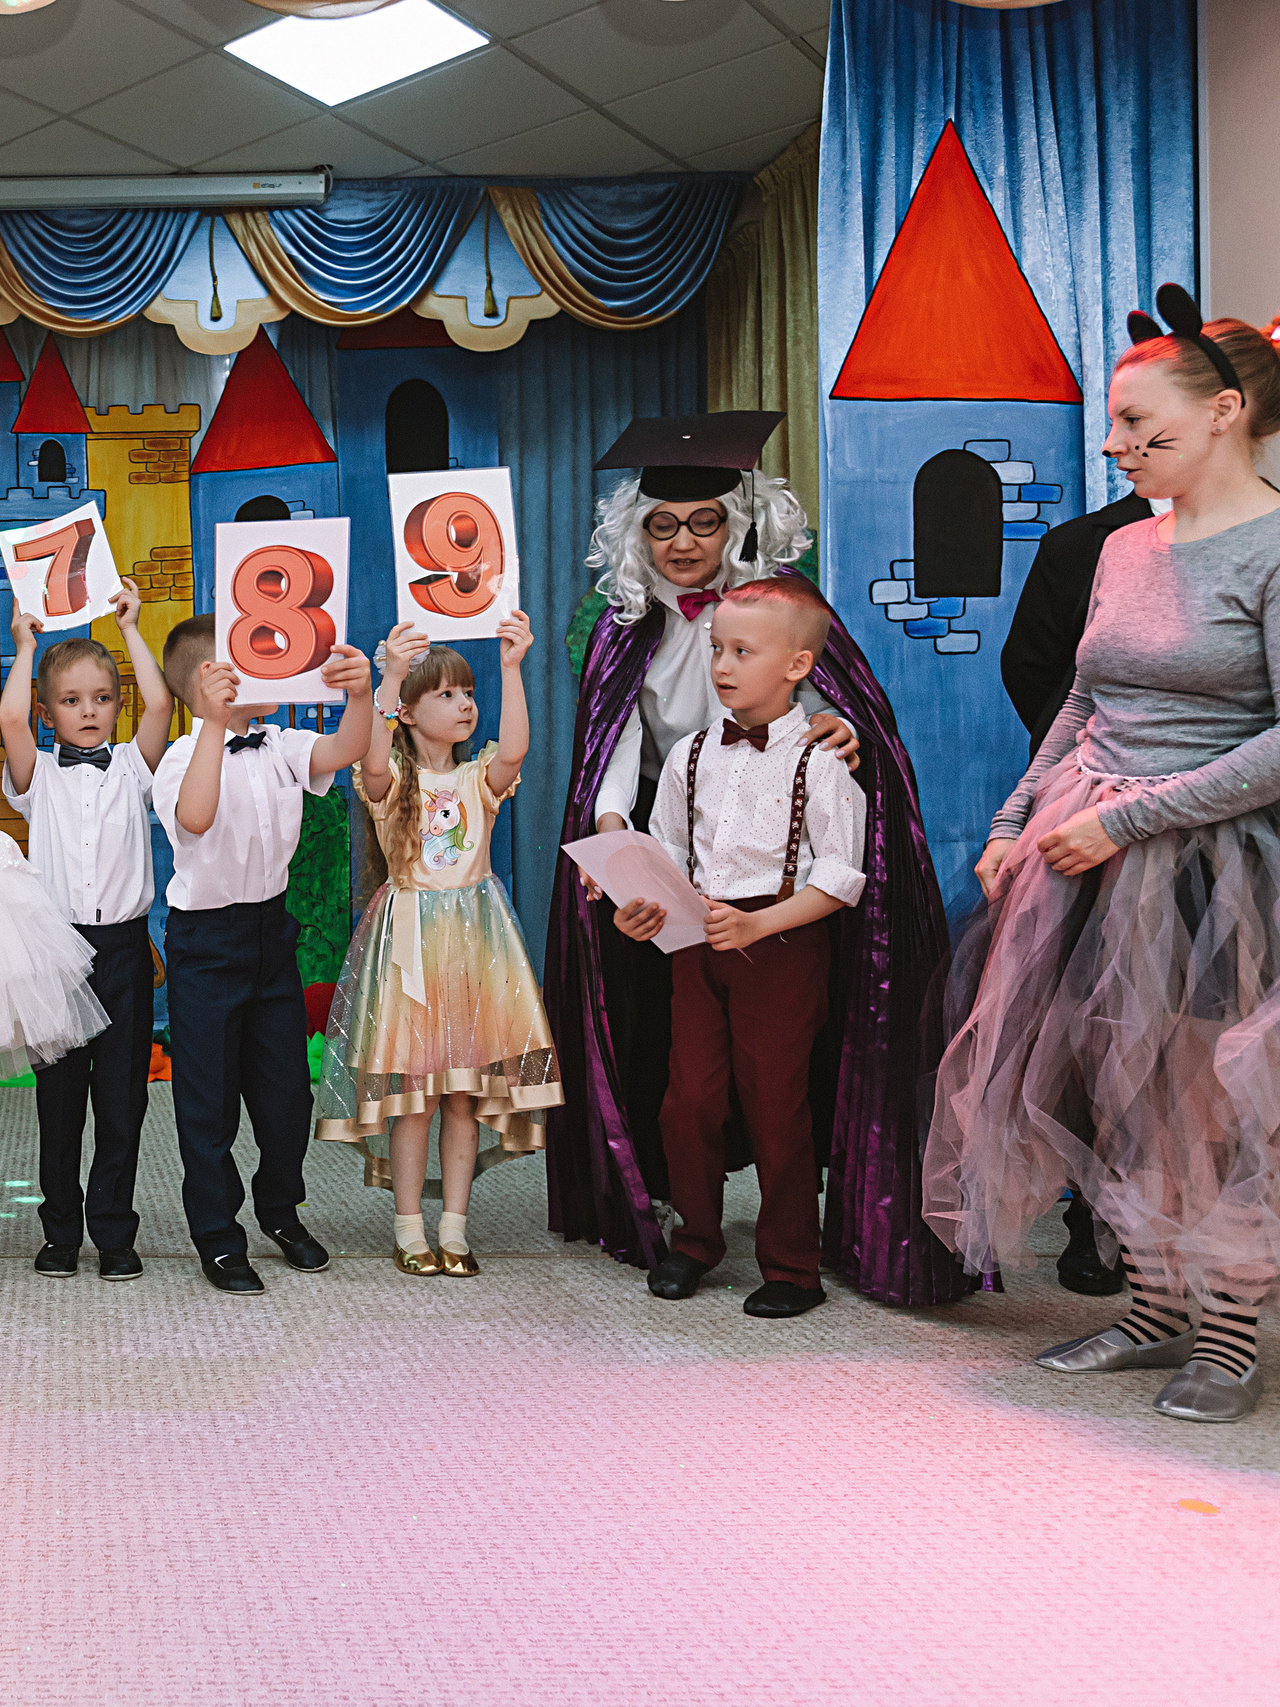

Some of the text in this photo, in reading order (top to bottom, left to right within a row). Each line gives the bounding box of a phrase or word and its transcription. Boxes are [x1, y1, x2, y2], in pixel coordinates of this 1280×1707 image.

[13, 518, 96, 617] 7
[227, 545, 337, 680] 8
[403, 491, 506, 618] 9
